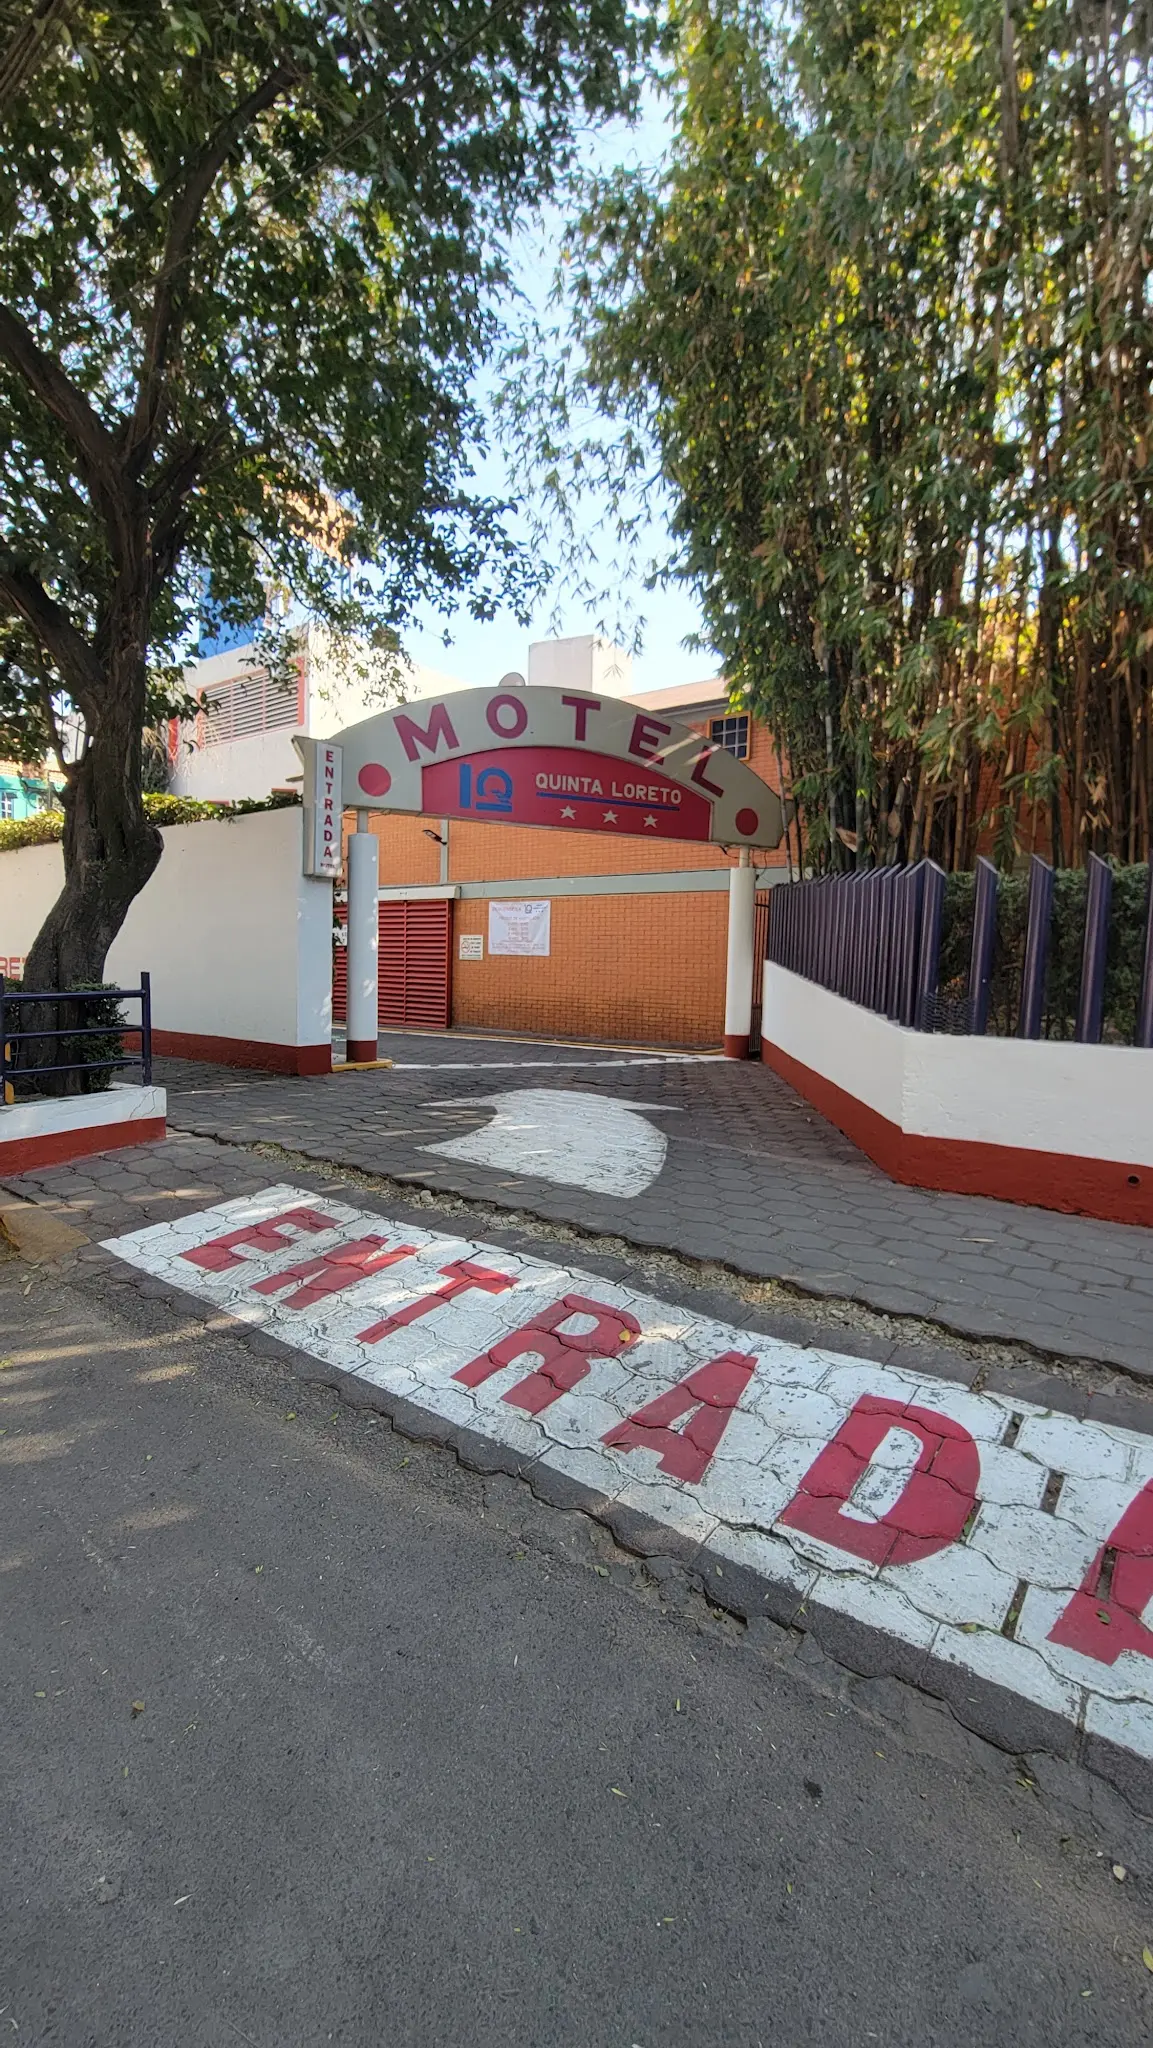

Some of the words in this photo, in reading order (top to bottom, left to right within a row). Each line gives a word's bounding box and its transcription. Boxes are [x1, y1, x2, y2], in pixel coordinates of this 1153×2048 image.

[393, 694, 724, 798] MOTEL
[535, 773, 604, 795] QUINTA
[611, 782, 682, 804] LORETO
[323, 750, 335, 858] ENTRADA
